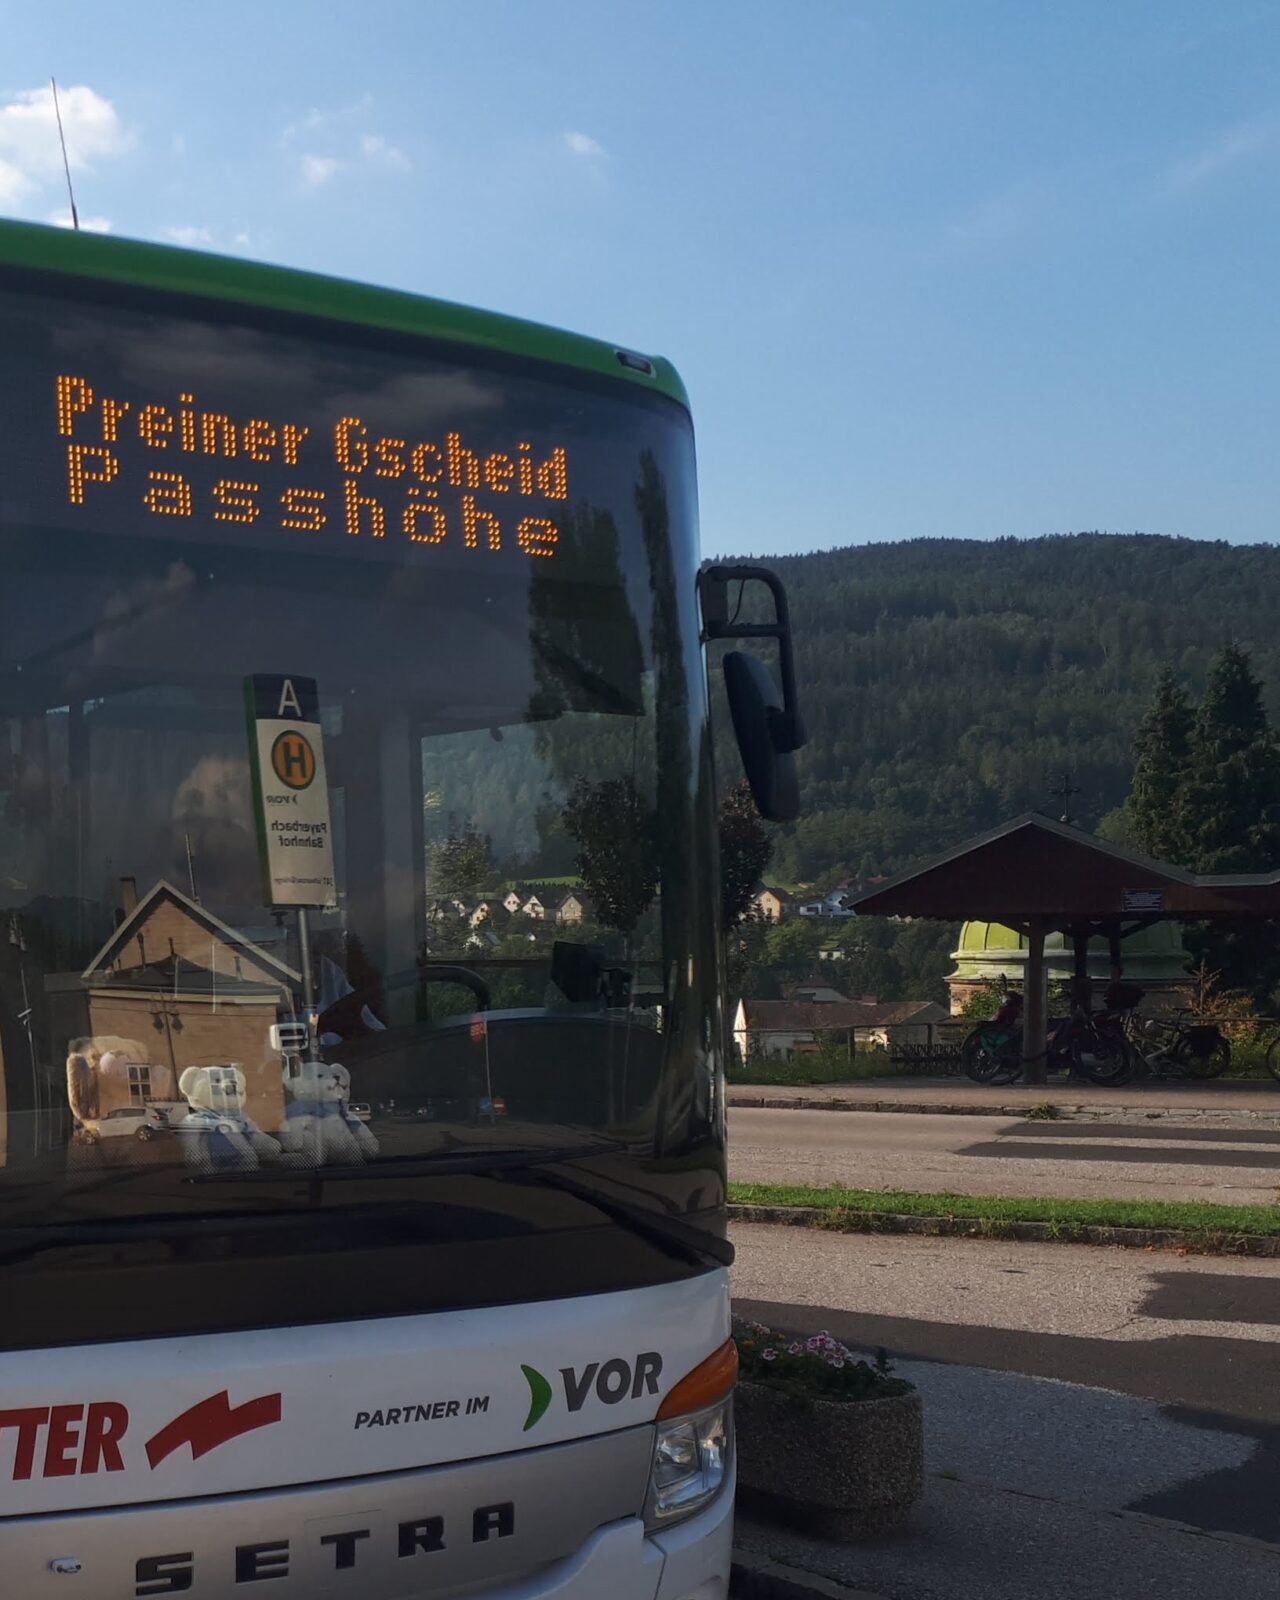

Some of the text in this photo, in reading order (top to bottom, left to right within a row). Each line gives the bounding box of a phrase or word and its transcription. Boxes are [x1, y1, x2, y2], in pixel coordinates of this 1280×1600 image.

[57, 375, 309, 465] Preiner
[335, 416, 568, 500] Gscheid
[69, 444, 558, 557] Passhöhe
[277, 679, 302, 717] A
[354, 1351, 664, 1429] PARTNER IM VOR
[135, 1501, 515, 1597] SETRA
